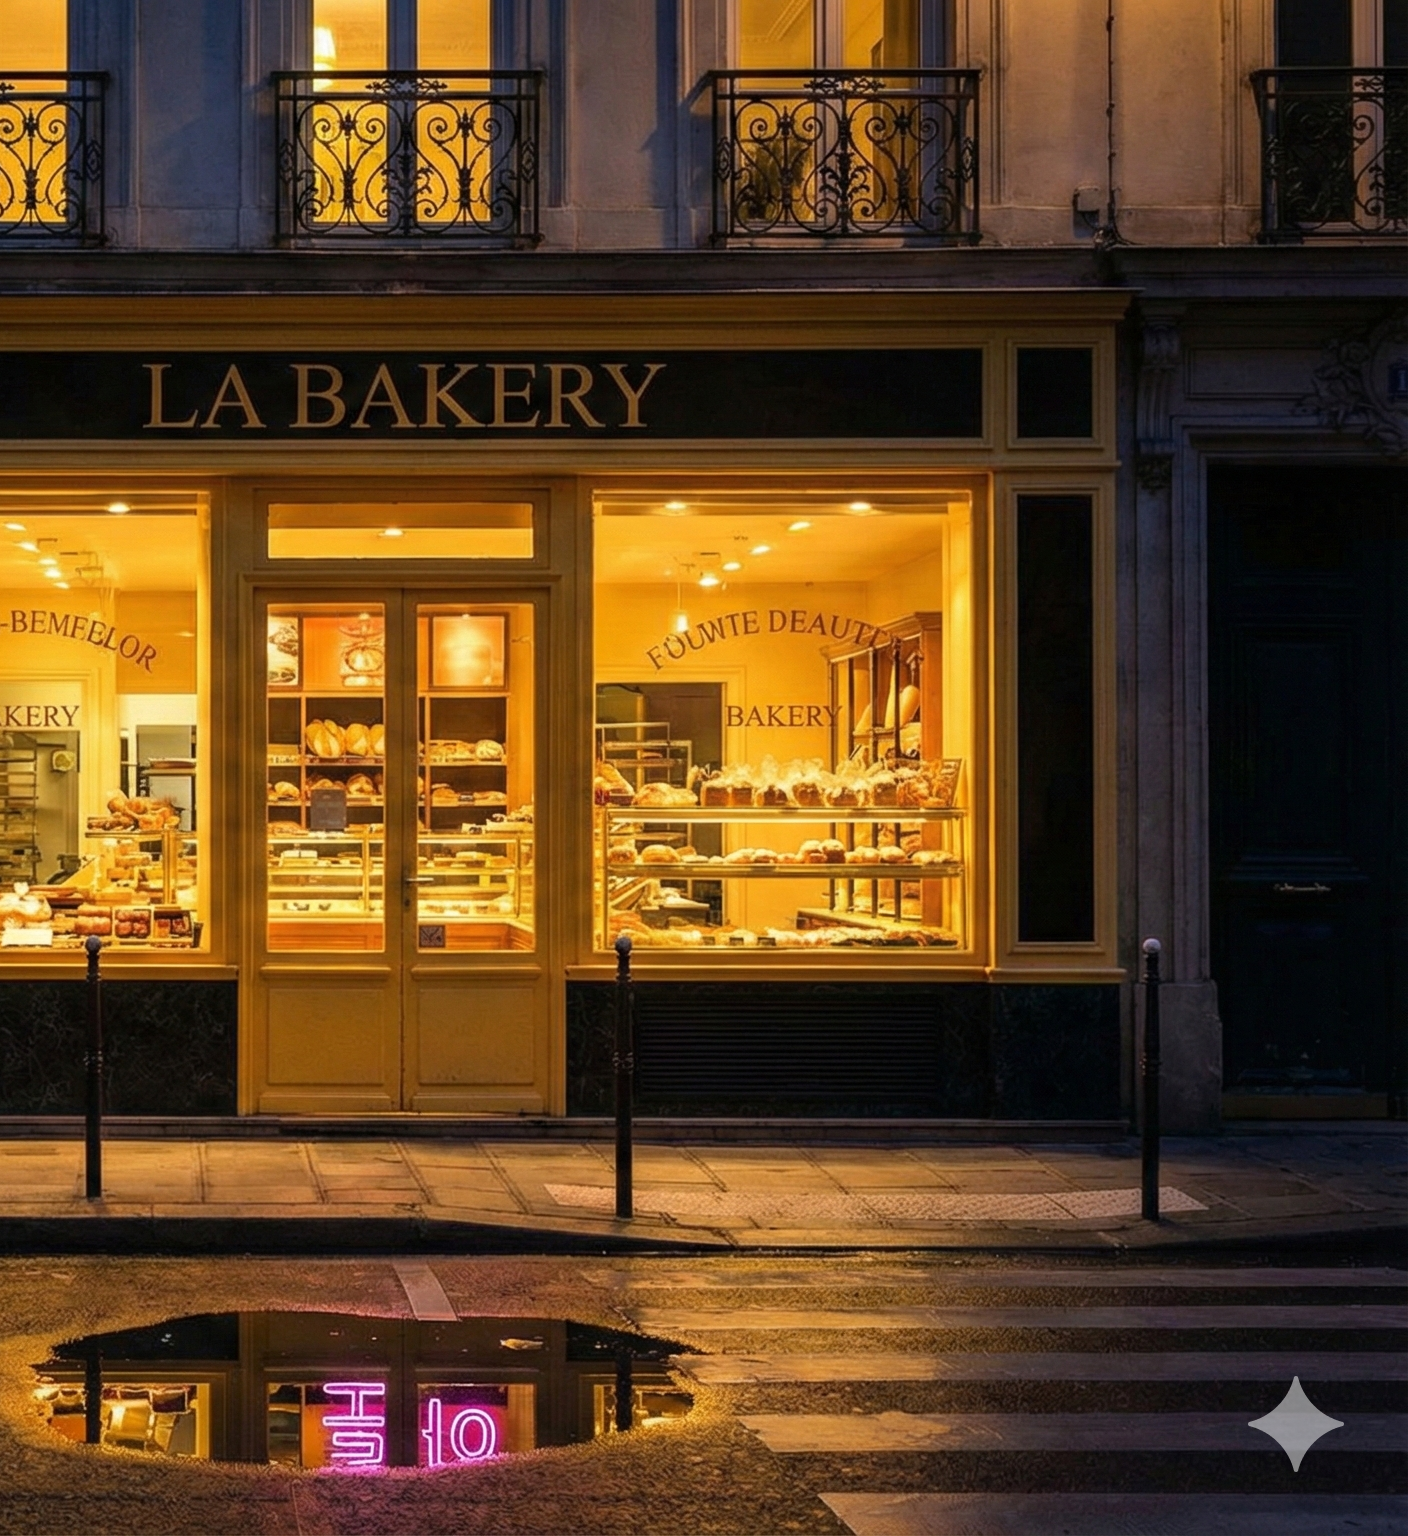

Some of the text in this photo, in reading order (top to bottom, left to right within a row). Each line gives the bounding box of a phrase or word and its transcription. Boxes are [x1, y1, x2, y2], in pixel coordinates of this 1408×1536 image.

[141, 363, 668, 429] LA BAKERY
[726, 704, 844, 728] BAKERY
